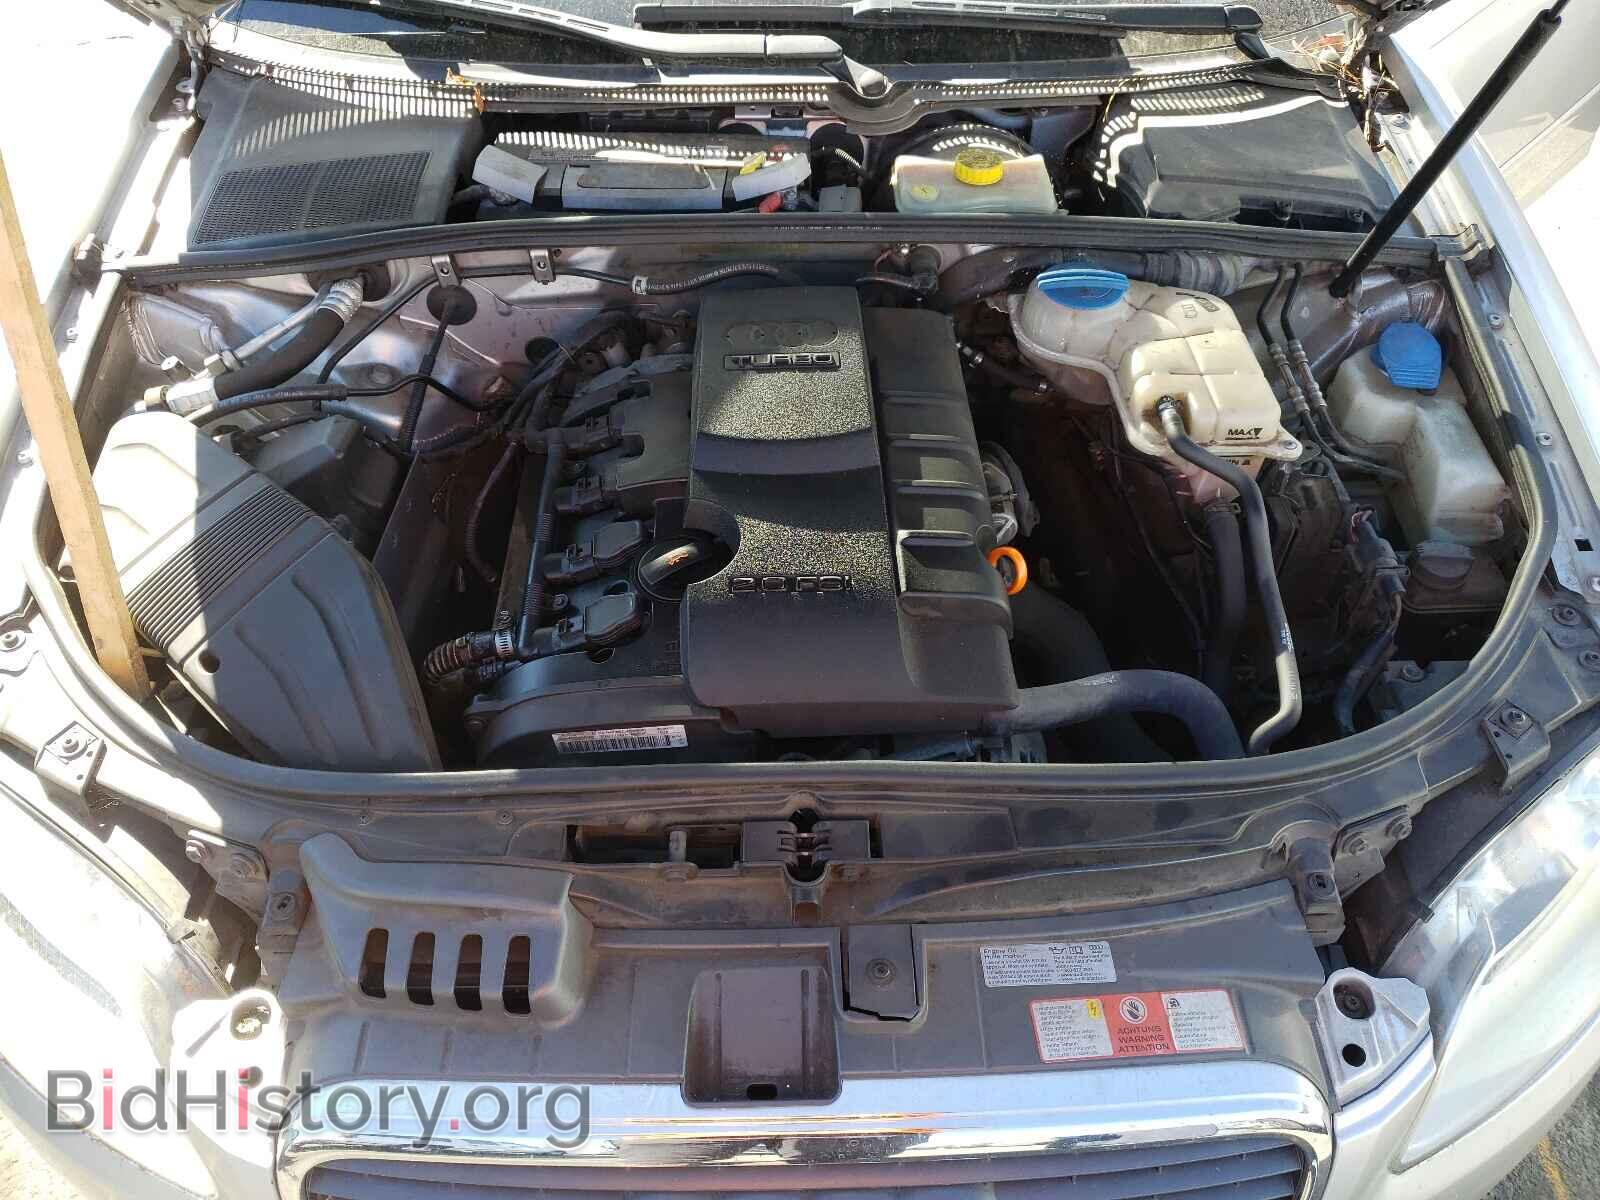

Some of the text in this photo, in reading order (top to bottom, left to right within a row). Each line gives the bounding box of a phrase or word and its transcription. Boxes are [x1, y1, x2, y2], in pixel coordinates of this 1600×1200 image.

[731, 353, 834, 366] TURBO
[1227, 428, 1253, 436] MAX
[1117, 1025, 1162, 1035] ACHTUNG
[1118, 1034, 1165, 1044] WARNING
[1119, 1043, 1170, 1054] ATTENTION
